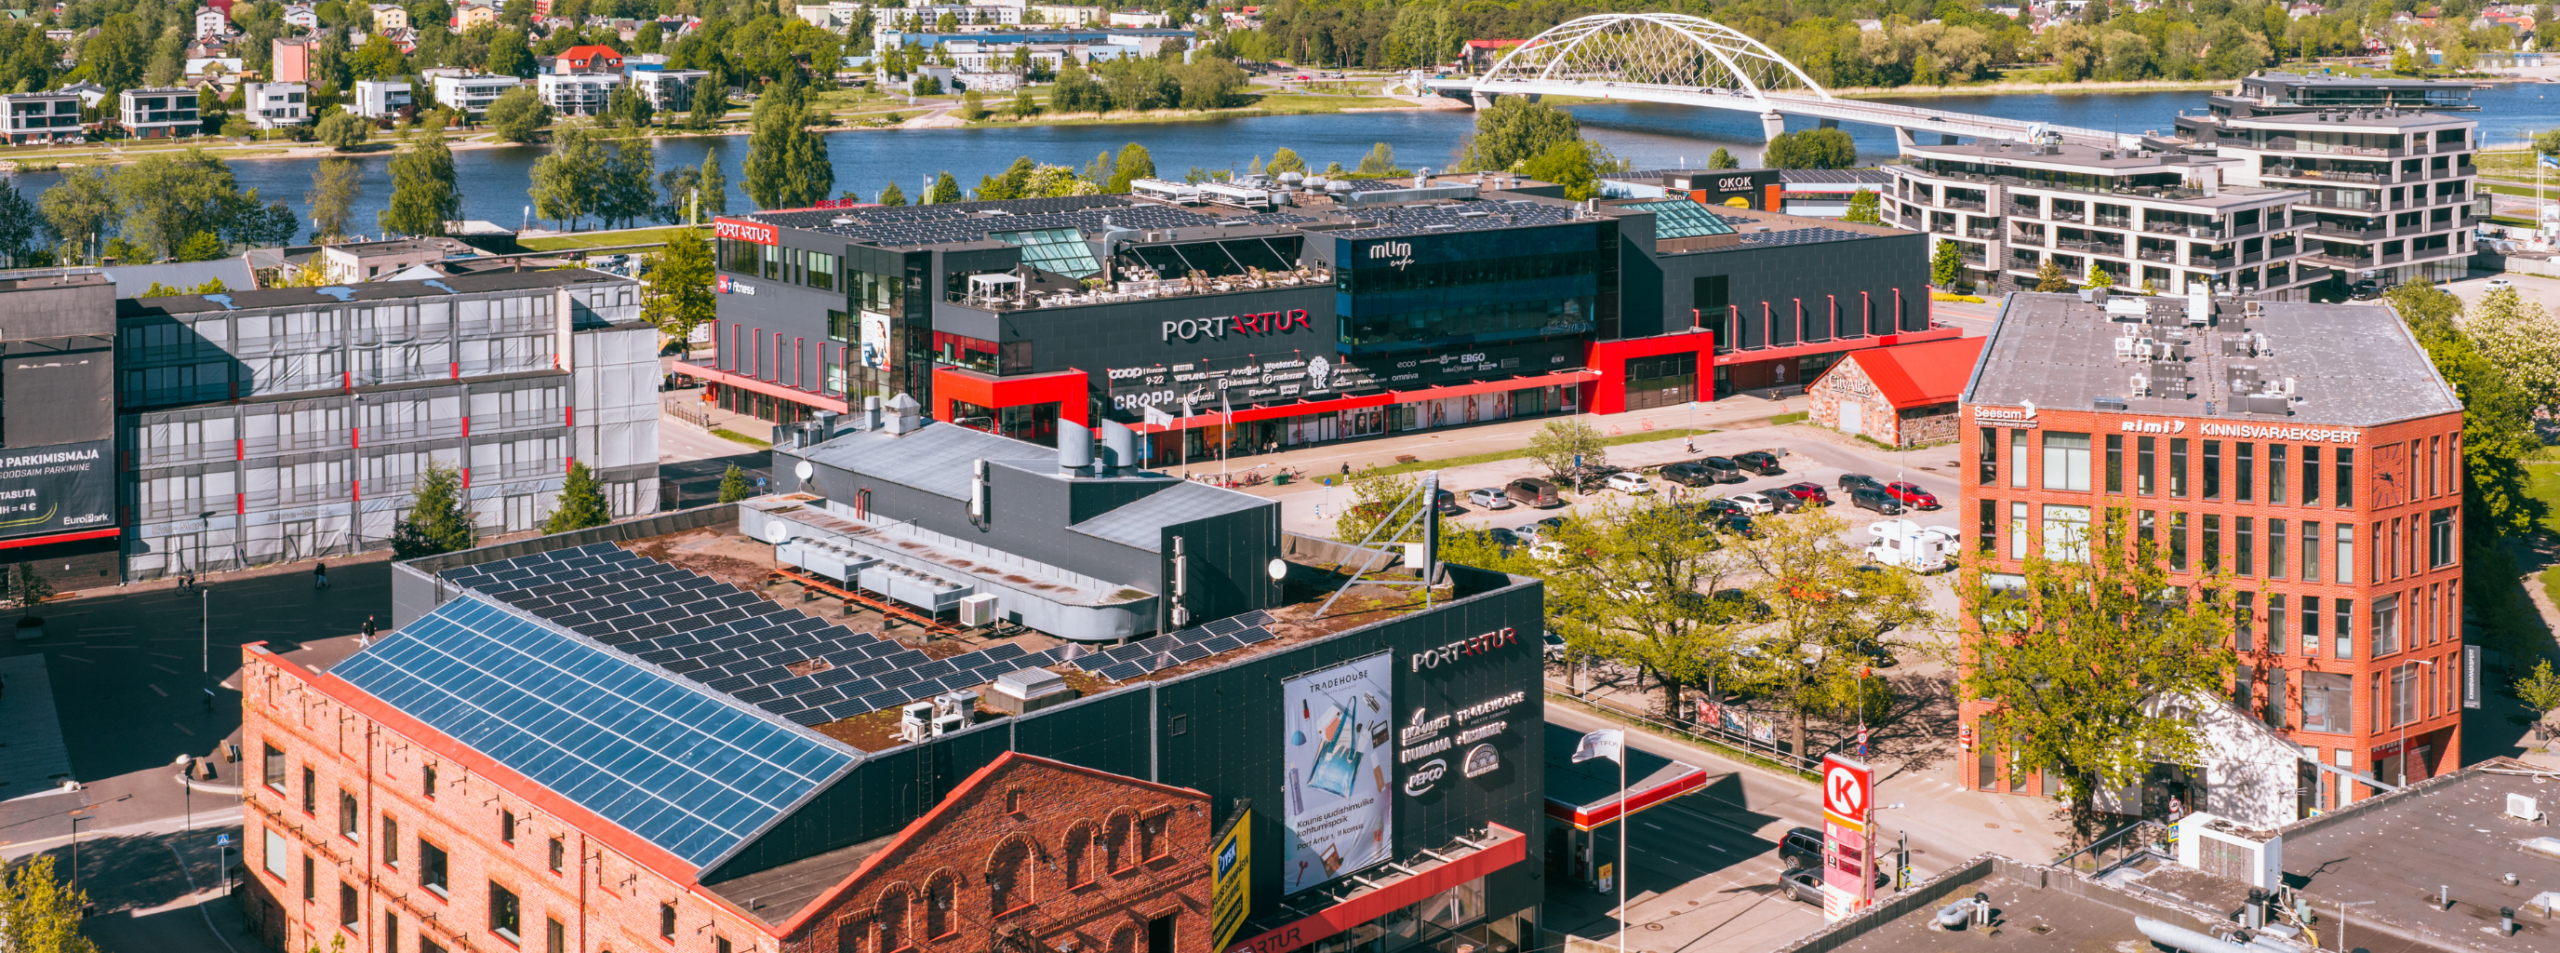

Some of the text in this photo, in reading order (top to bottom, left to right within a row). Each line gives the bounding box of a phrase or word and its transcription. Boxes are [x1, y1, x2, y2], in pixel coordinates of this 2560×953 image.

[1718, 176, 1752, 188] OKOK
[816, 198, 853, 209] PESE ISE
[733, 281, 756, 296] Fitness
[1461, 353, 1486, 364] ERGO
[1146, 375, 1165, 386] 9-22
[1391, 372, 1419, 382] omniva
[1829, 374, 1871, 395] CityAlko
[1114, 389, 1175, 411] CROPP
[1974, 405, 2023, 419] Seesam
[2200, 422, 2361, 444] KINNISVARAEKSPERT
[6, 449, 99, 467] PARKIMISMAJA
[44, 463, 91, 475] PARKIMINE
[20, 503, 26, 511] 4
[29, 502, 36, 511] €
[63, 513, 109, 525] EuroPark
[1310, 669, 1369, 693] TRADEHOUSE
[1456, 691, 1525, 723] TRADEHOUSE
[1401, 736, 1452, 764] HUMANA
[1409, 766, 1444, 789] PEPCO
[1835, 774, 1857, 814] K
[1297, 798, 1374, 829] Kaunis uudishimulike
[1296, 815, 1348, 838] kohtumispaik
[1297, 841, 1312, 851] Port
[1313, 834, 1330, 845] Artur
[1343, 822, 1364, 835] korrus
[1222, 842, 1237, 872] JYSK
